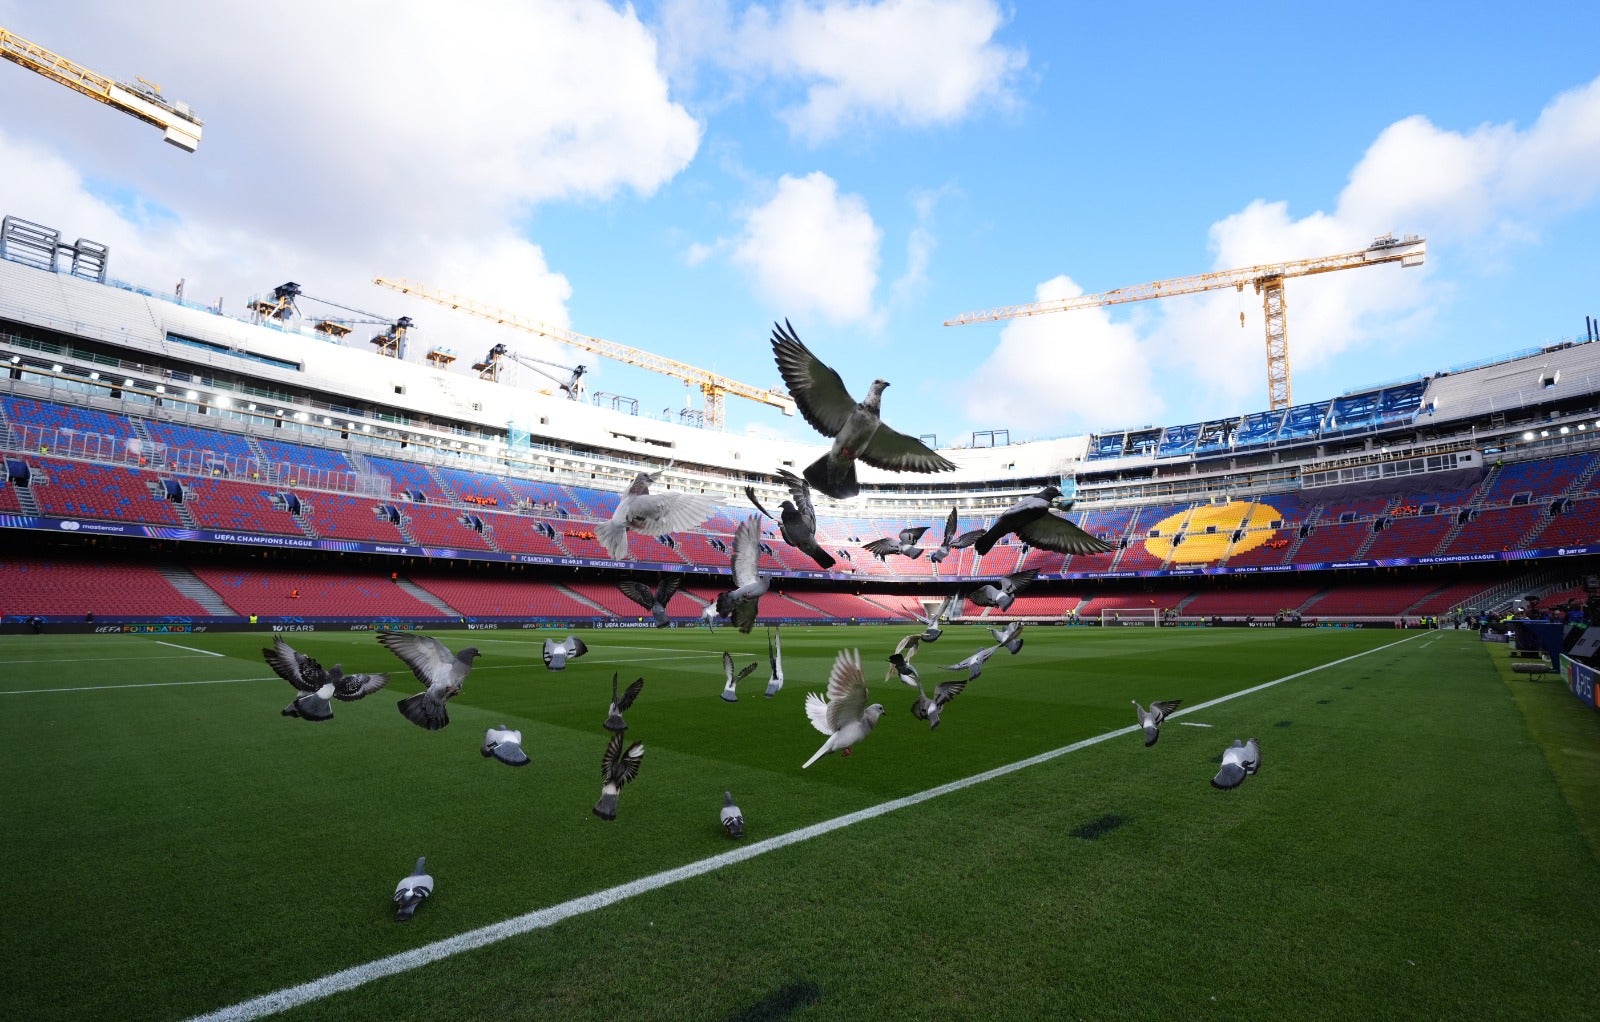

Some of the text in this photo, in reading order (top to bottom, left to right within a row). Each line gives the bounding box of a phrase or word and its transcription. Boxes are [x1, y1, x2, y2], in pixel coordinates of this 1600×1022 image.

[82, 524, 124, 532] mastercard
[237, 536, 283, 545] CHAMPIONS
[124, 625, 191, 633] FOUNDATION
